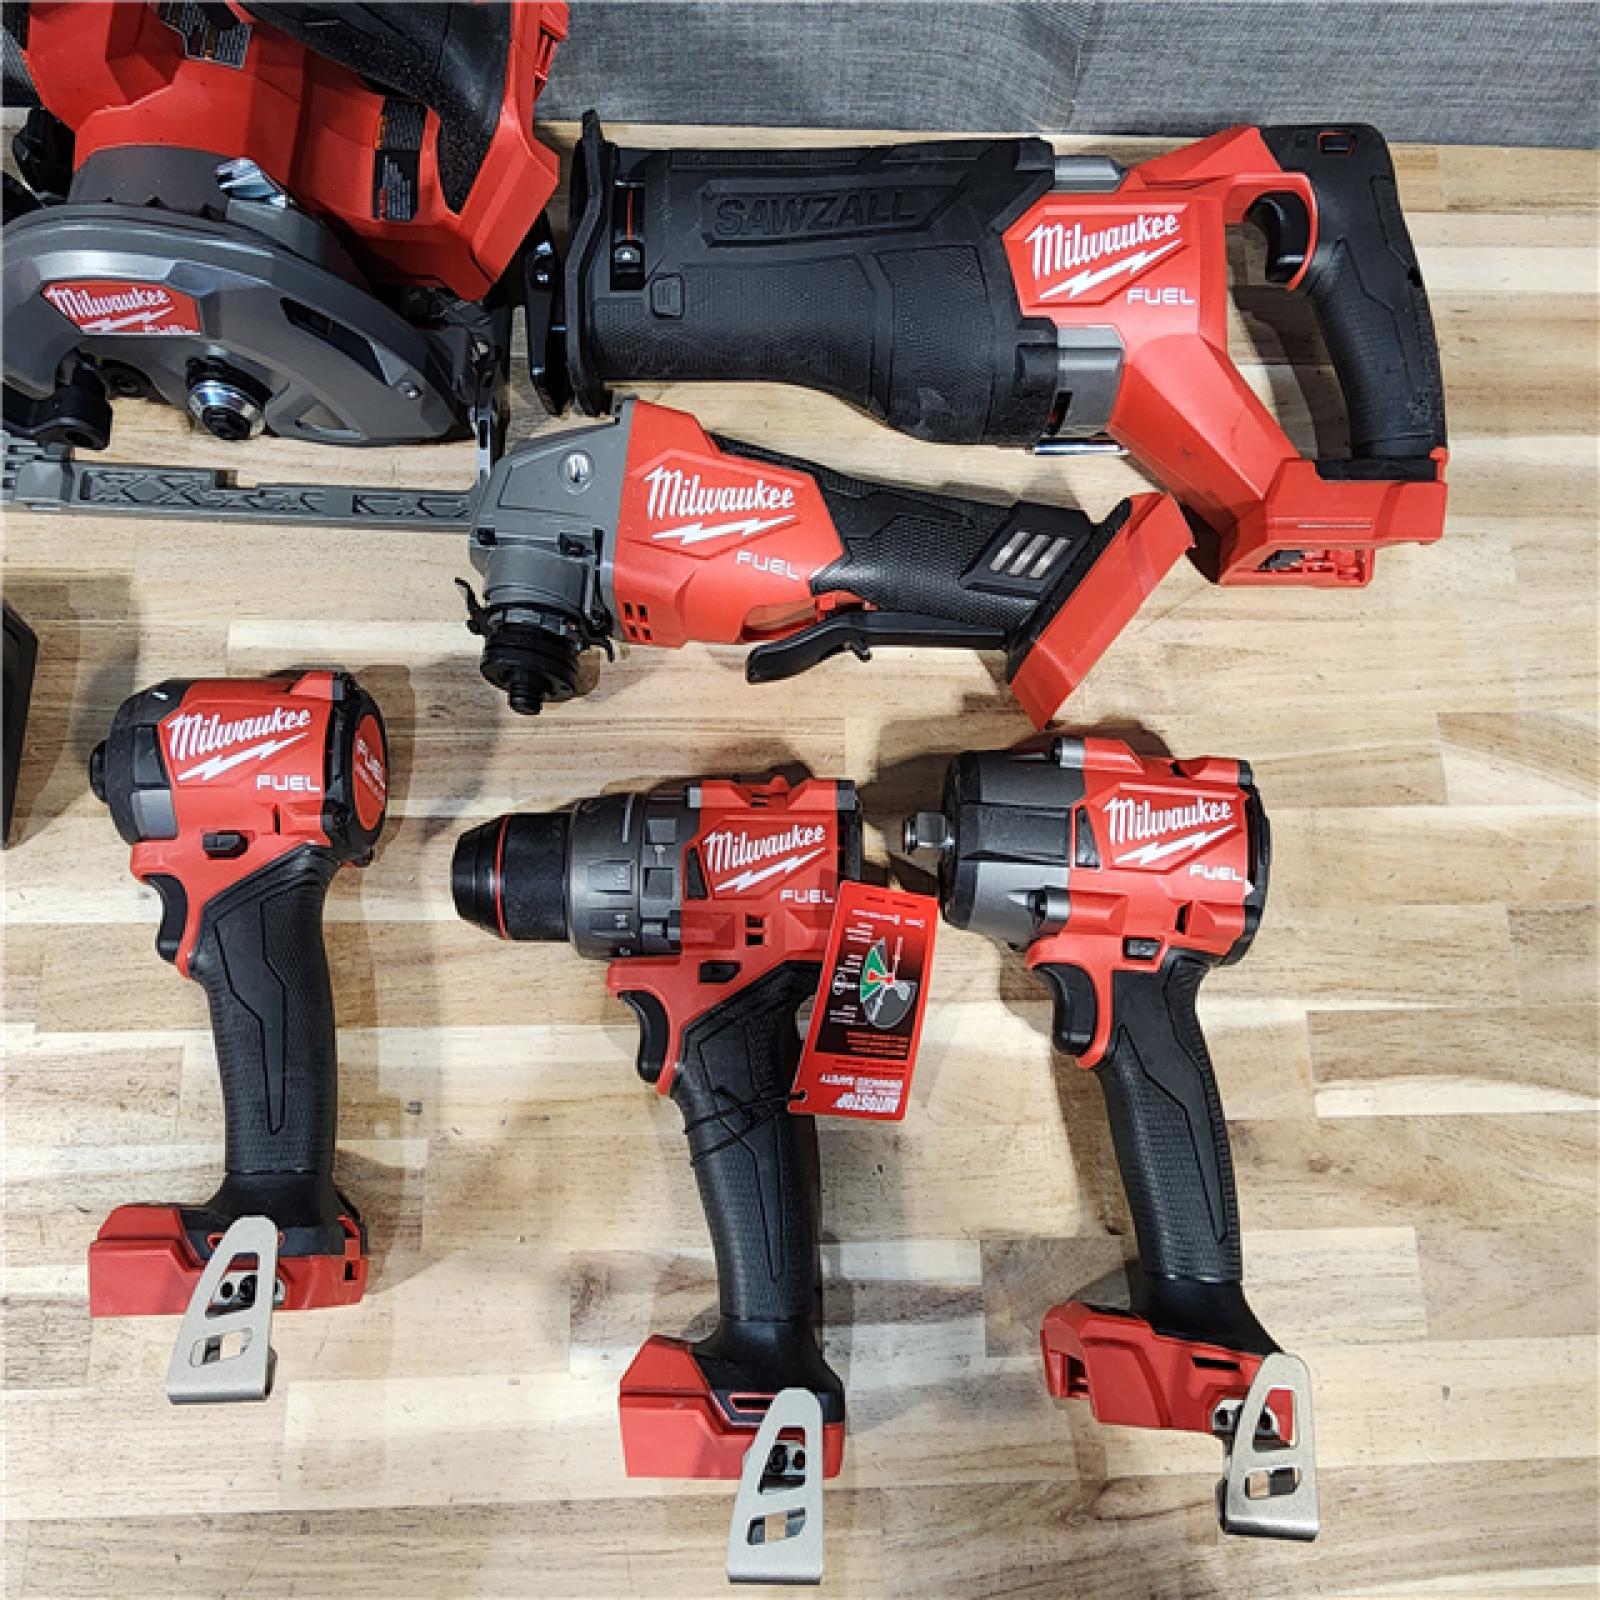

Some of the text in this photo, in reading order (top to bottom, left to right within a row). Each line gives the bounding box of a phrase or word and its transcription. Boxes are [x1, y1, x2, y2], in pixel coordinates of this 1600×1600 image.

[713, 191, 918, 236] SAWZALL
[1024, 214, 1181, 281] Milwaukee
[43, 287, 171, 320] Milwaukee
[1126, 287, 1197, 305] FUEL
[644, 465, 796, 521] Milwaukee
[735, 549, 800, 581] FUEL
[167, 706, 311, 761] Milwaukee
[256, 774, 321, 791] FUEL
[1103, 796, 1233, 846] Milwaukee
[702, 824, 826, 874] Milwaukee
[1189, 863, 1244, 881] FUEL
[779, 889, 836, 904] FUEL
